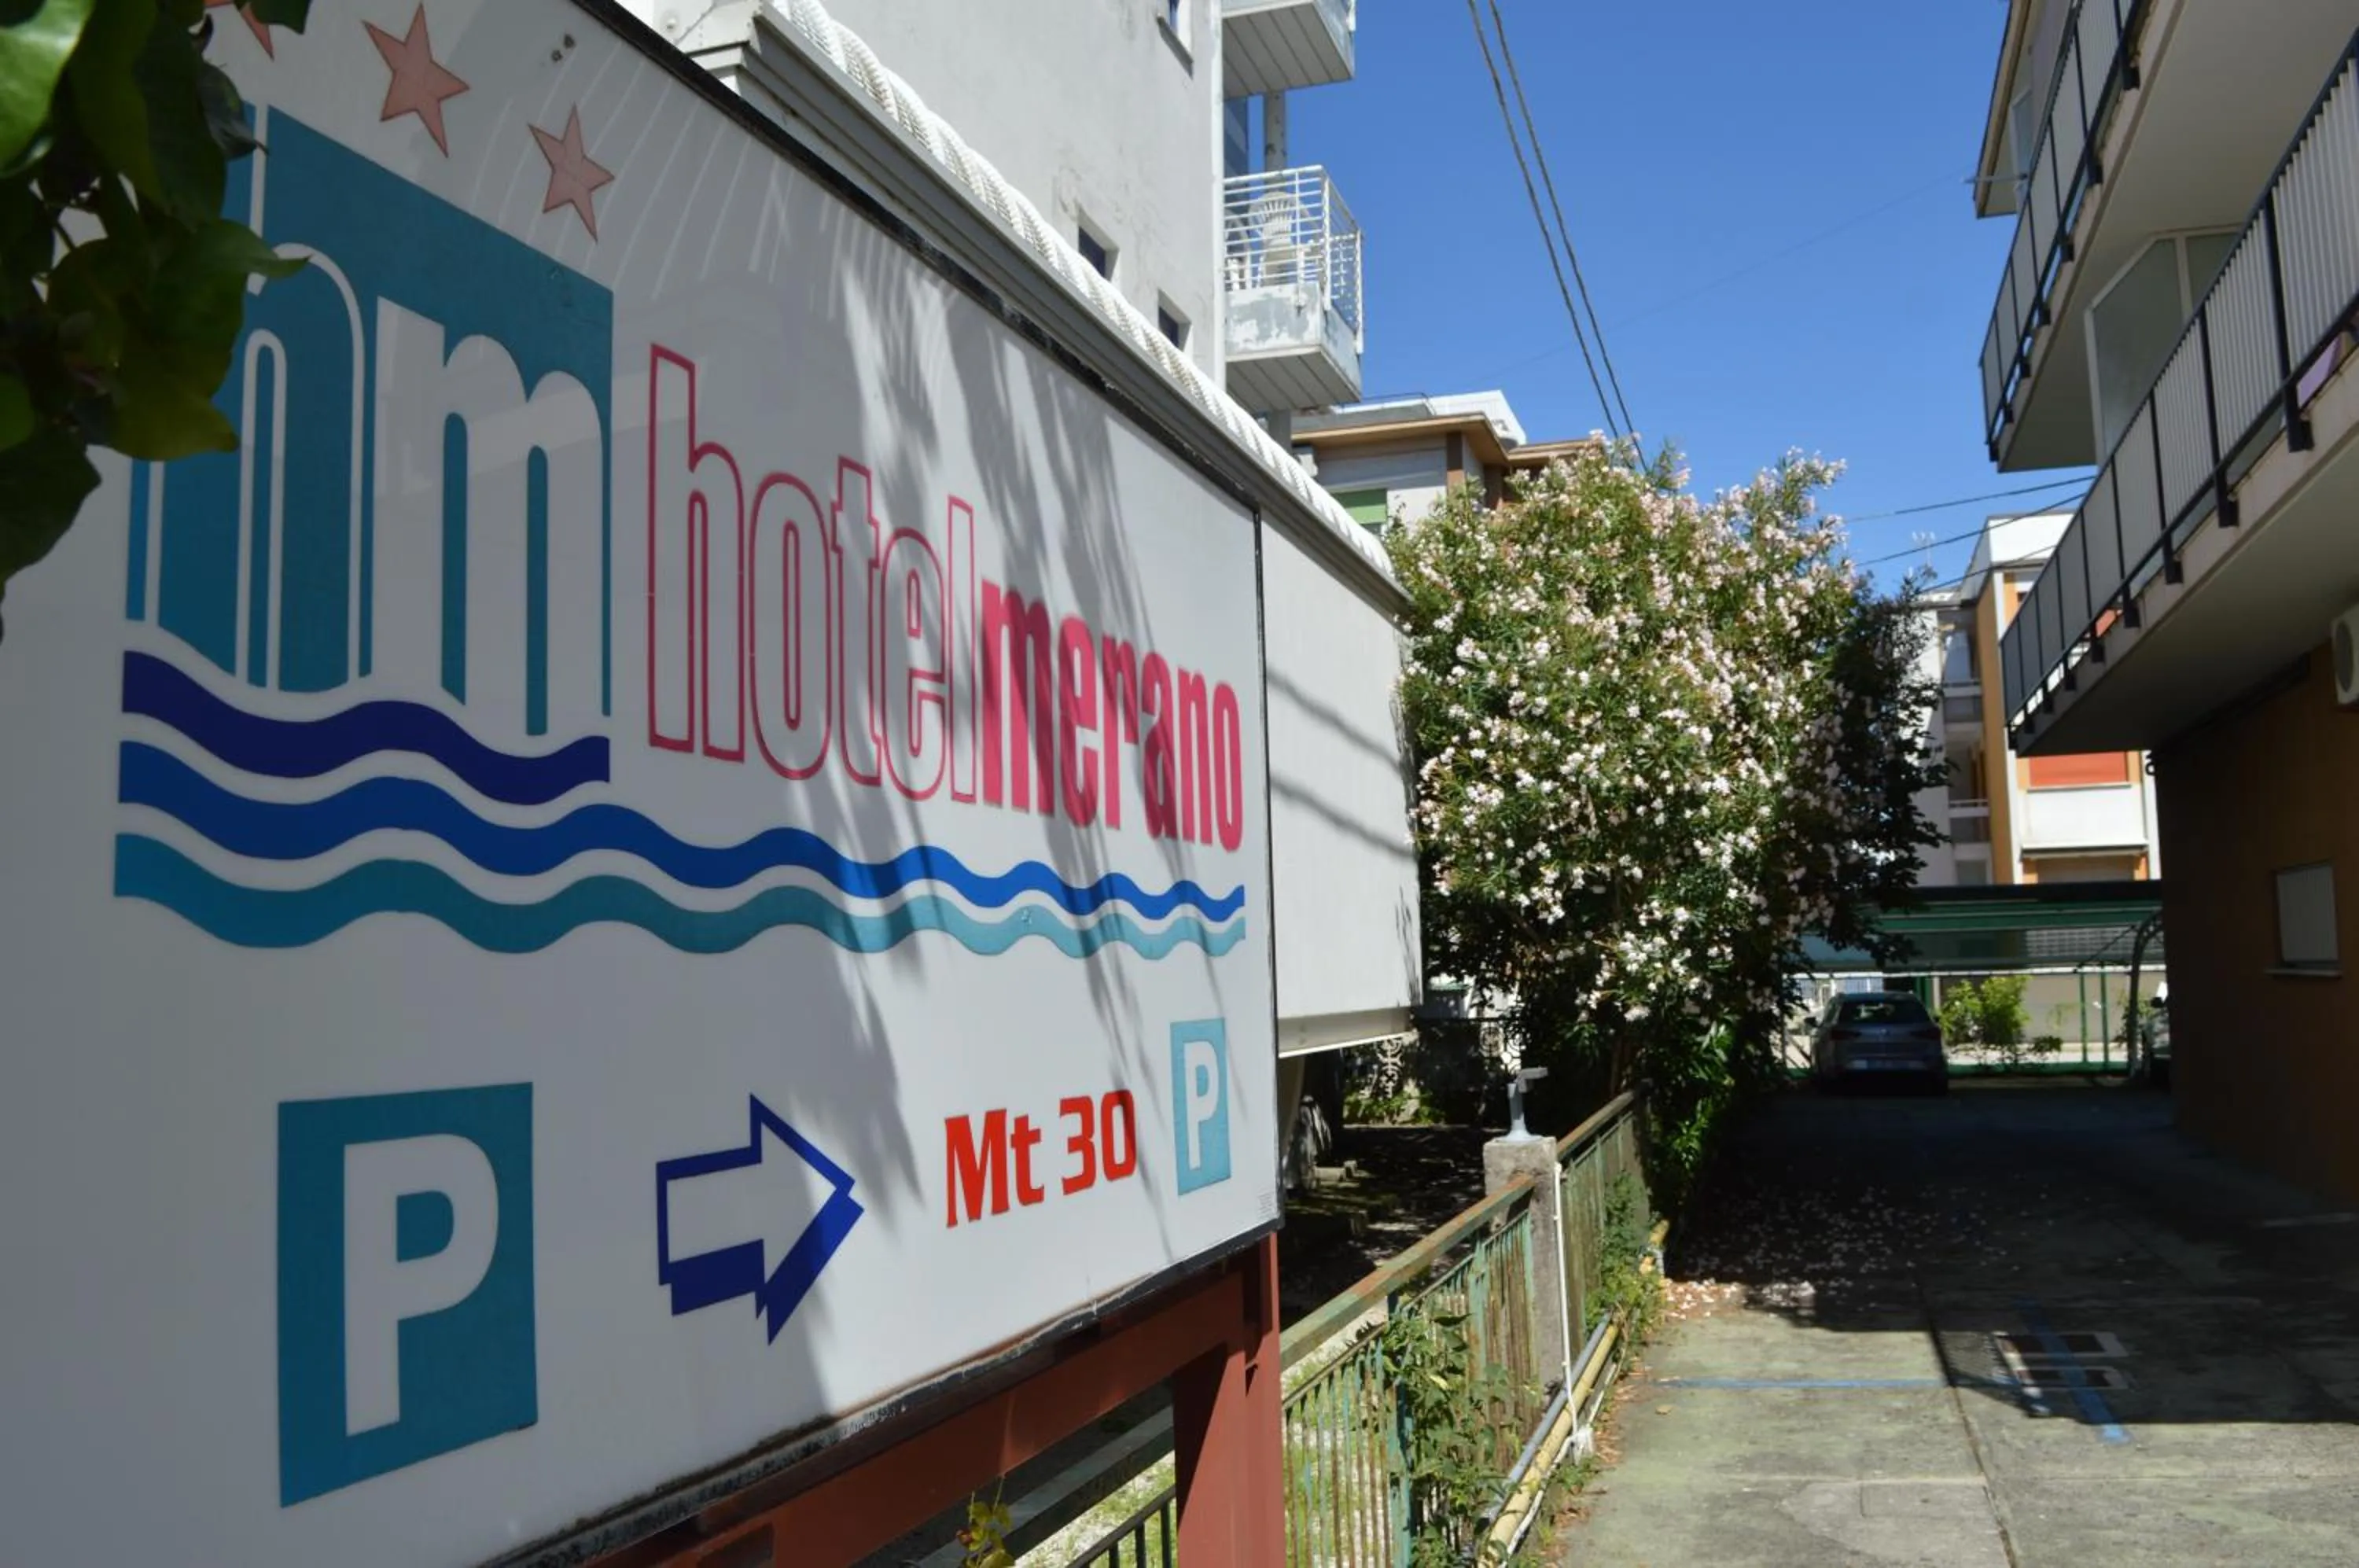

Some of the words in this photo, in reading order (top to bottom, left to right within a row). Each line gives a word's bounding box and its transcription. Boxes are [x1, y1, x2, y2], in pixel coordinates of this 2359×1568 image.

[944, 1108, 1045, 1229] Mt
[1058, 1088, 1138, 1195] 30
[1183, 1040, 1220, 1171] P
[344, 1133, 499, 1437] P
